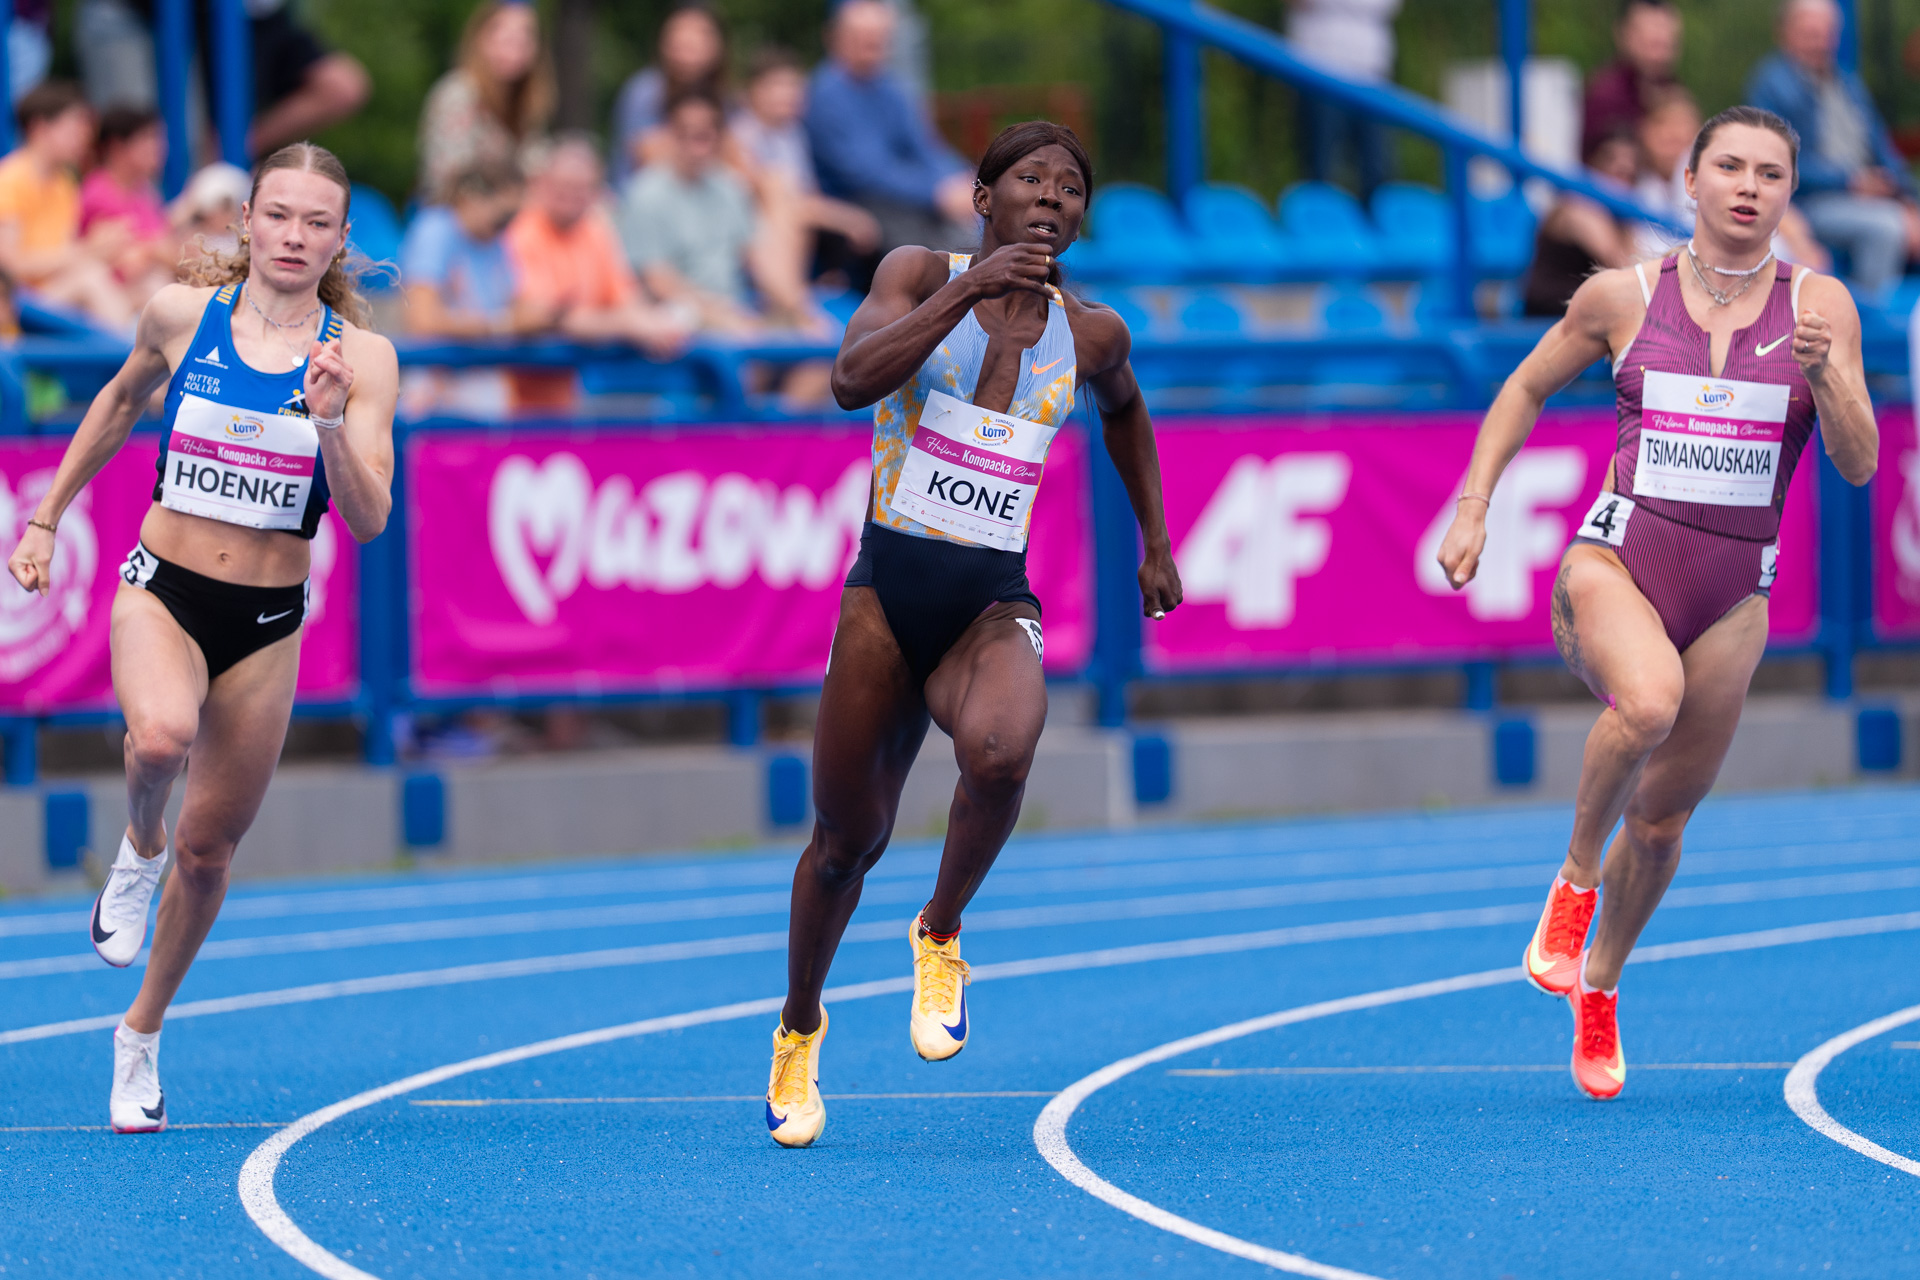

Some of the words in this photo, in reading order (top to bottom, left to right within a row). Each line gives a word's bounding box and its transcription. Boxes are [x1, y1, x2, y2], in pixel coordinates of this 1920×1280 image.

[183, 380, 221, 396] KOLLER
[186, 371, 221, 387] RITTER
[277, 406, 312, 420] FRICK
[1704, 393, 1727, 403] LOTTO
[233, 423, 257, 434] LOTTO
[982, 425, 1007, 438] LOTTO
[1651, 414, 1686, 430] Halina
[1688, 417, 1738, 436] Konopacka
[1739, 425, 1773, 437] Classic
[180, 438, 216, 455] Halina
[217, 445, 267, 467] Konopacka
[268, 456, 303, 470] Classic
[926, 436, 960, 458] Halina
[961, 449, 1011, 475] Konopacka
[1013, 465, 1036, 478] Classic
[1646, 438, 1771, 475] TSIMANOUSKAYA
[174, 460, 300, 508] HOENKE
[927, 470, 1022, 521] KONÉ
[1413, 446, 1589, 622] 4F
[1591, 499, 1620, 538] 4
[1175, 452, 1354, 630] 4F
